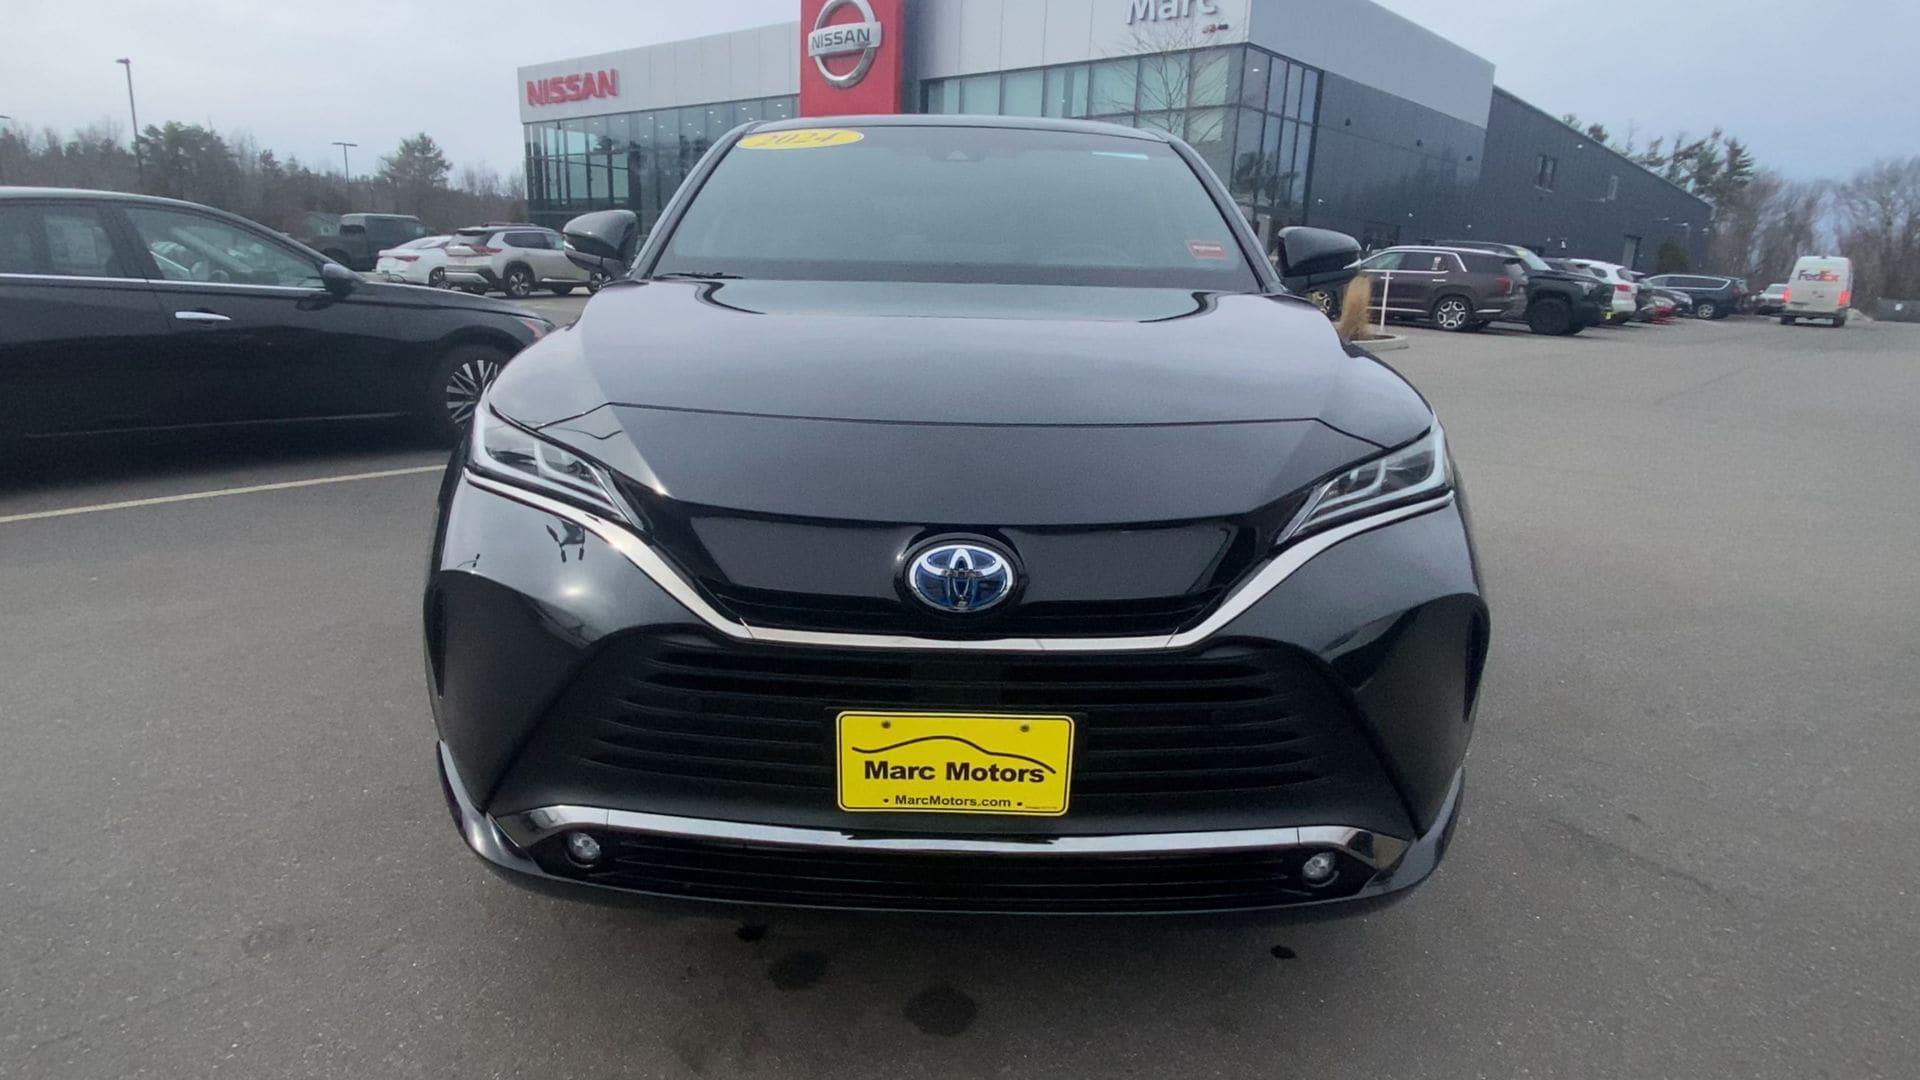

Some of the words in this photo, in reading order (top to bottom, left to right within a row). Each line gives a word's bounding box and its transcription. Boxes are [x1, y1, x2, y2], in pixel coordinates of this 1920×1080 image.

[1125, 0, 1218, 25] Marc
[811, 28, 870, 50] NISSAN
[526, 69, 619, 106] NISSAN
[754, 131, 840, 147] 2024
[1797, 269, 1840, 282] FedEx
[864, 760, 935, 780] Marc
[946, 762, 1045, 783] Motors
[895, 795, 1011, 808] MarcMotors.com
